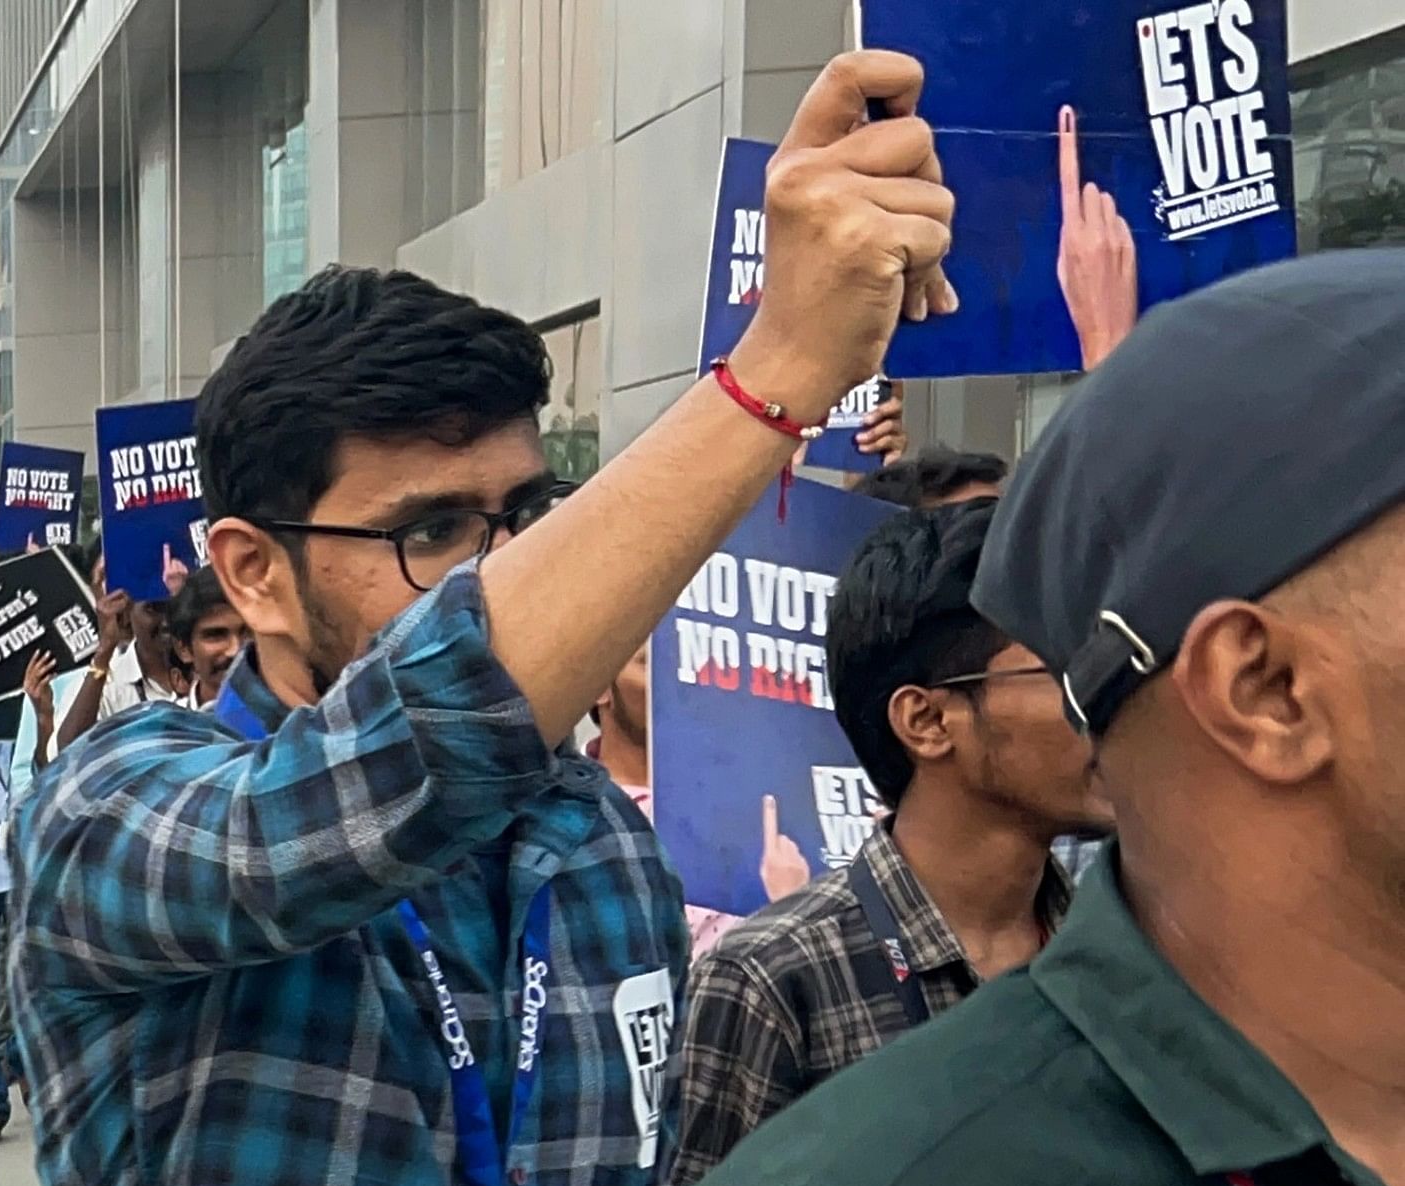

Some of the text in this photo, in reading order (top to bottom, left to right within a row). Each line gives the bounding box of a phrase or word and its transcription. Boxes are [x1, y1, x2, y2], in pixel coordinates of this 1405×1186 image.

[1150, 90, 1273, 198] VOTE
[1167, 181, 1277, 231] www.letsvote.in
[6, 468, 69, 491] NO VOTE
[110, 437, 197, 479] NO VOT
[5, 489, 75, 512] NO RIGHT
[114, 478, 148, 511] NO
[677, 552, 838, 637] NO VOT
[66, 622, 99, 653] VOTE
[677, 617, 740, 690] NO
[884, 939, 910, 983] VEDA
